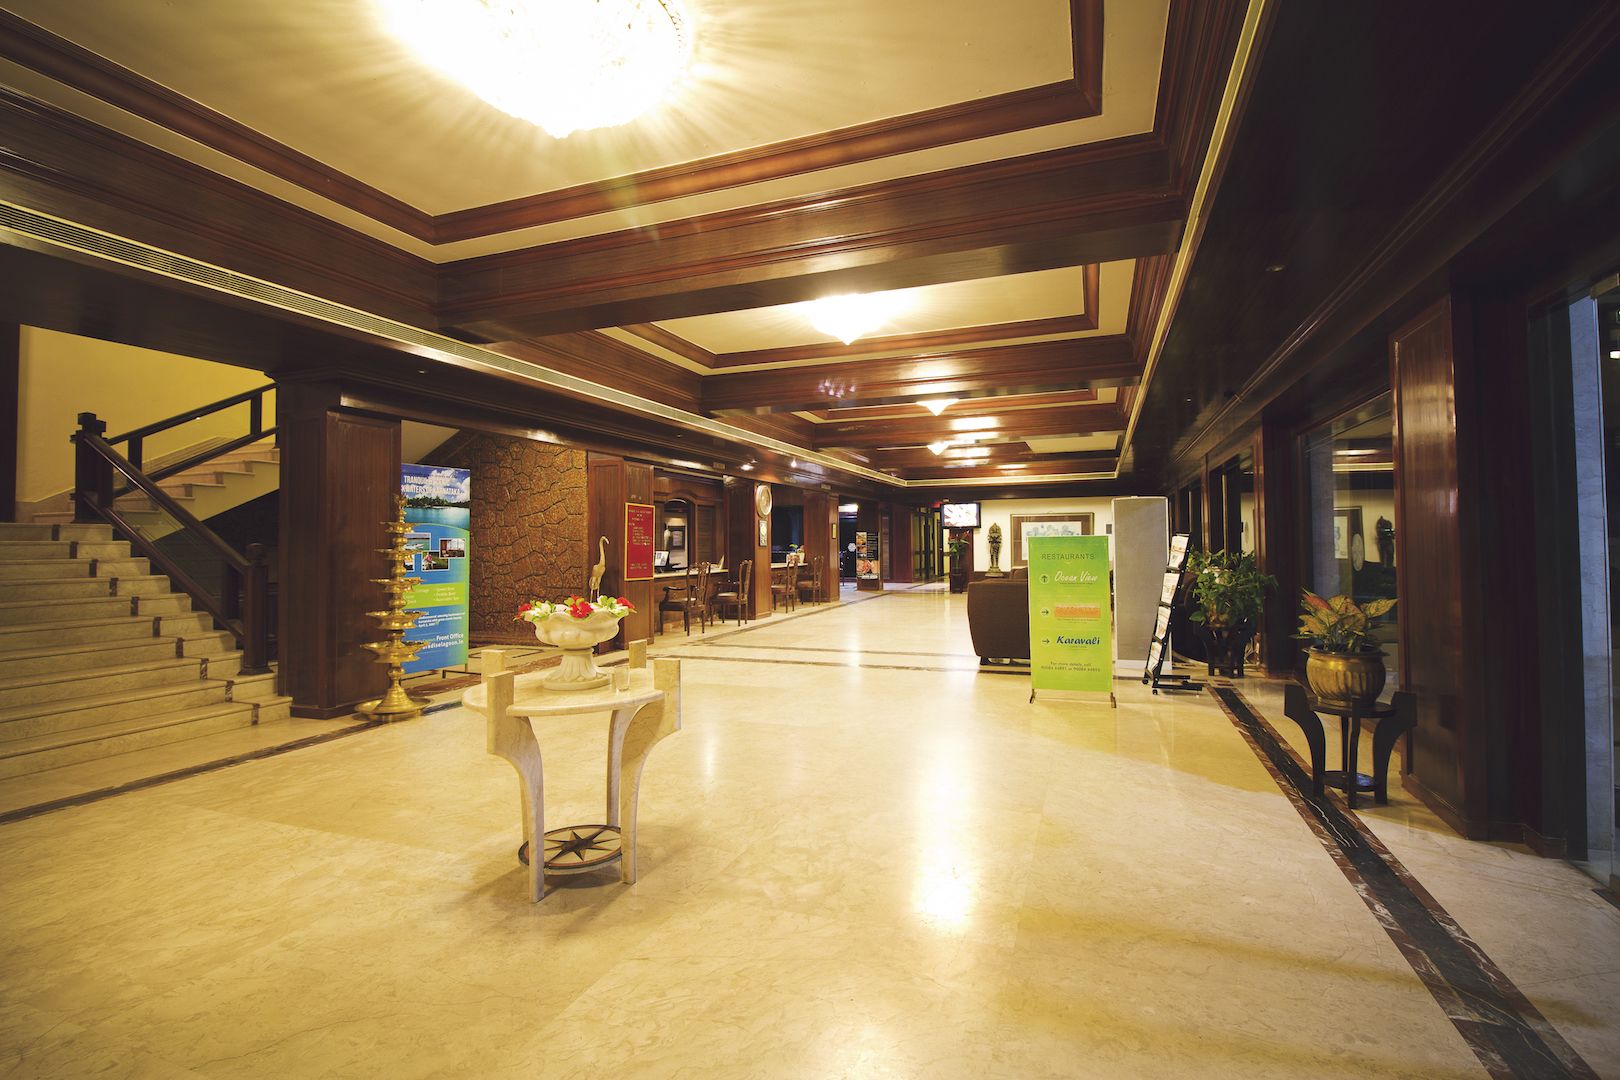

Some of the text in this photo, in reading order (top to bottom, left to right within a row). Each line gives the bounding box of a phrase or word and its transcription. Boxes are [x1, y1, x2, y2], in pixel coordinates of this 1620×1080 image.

[1055, 570, 1098, 582] Ocean View
[1056, 635, 1100, 645] Karavali
